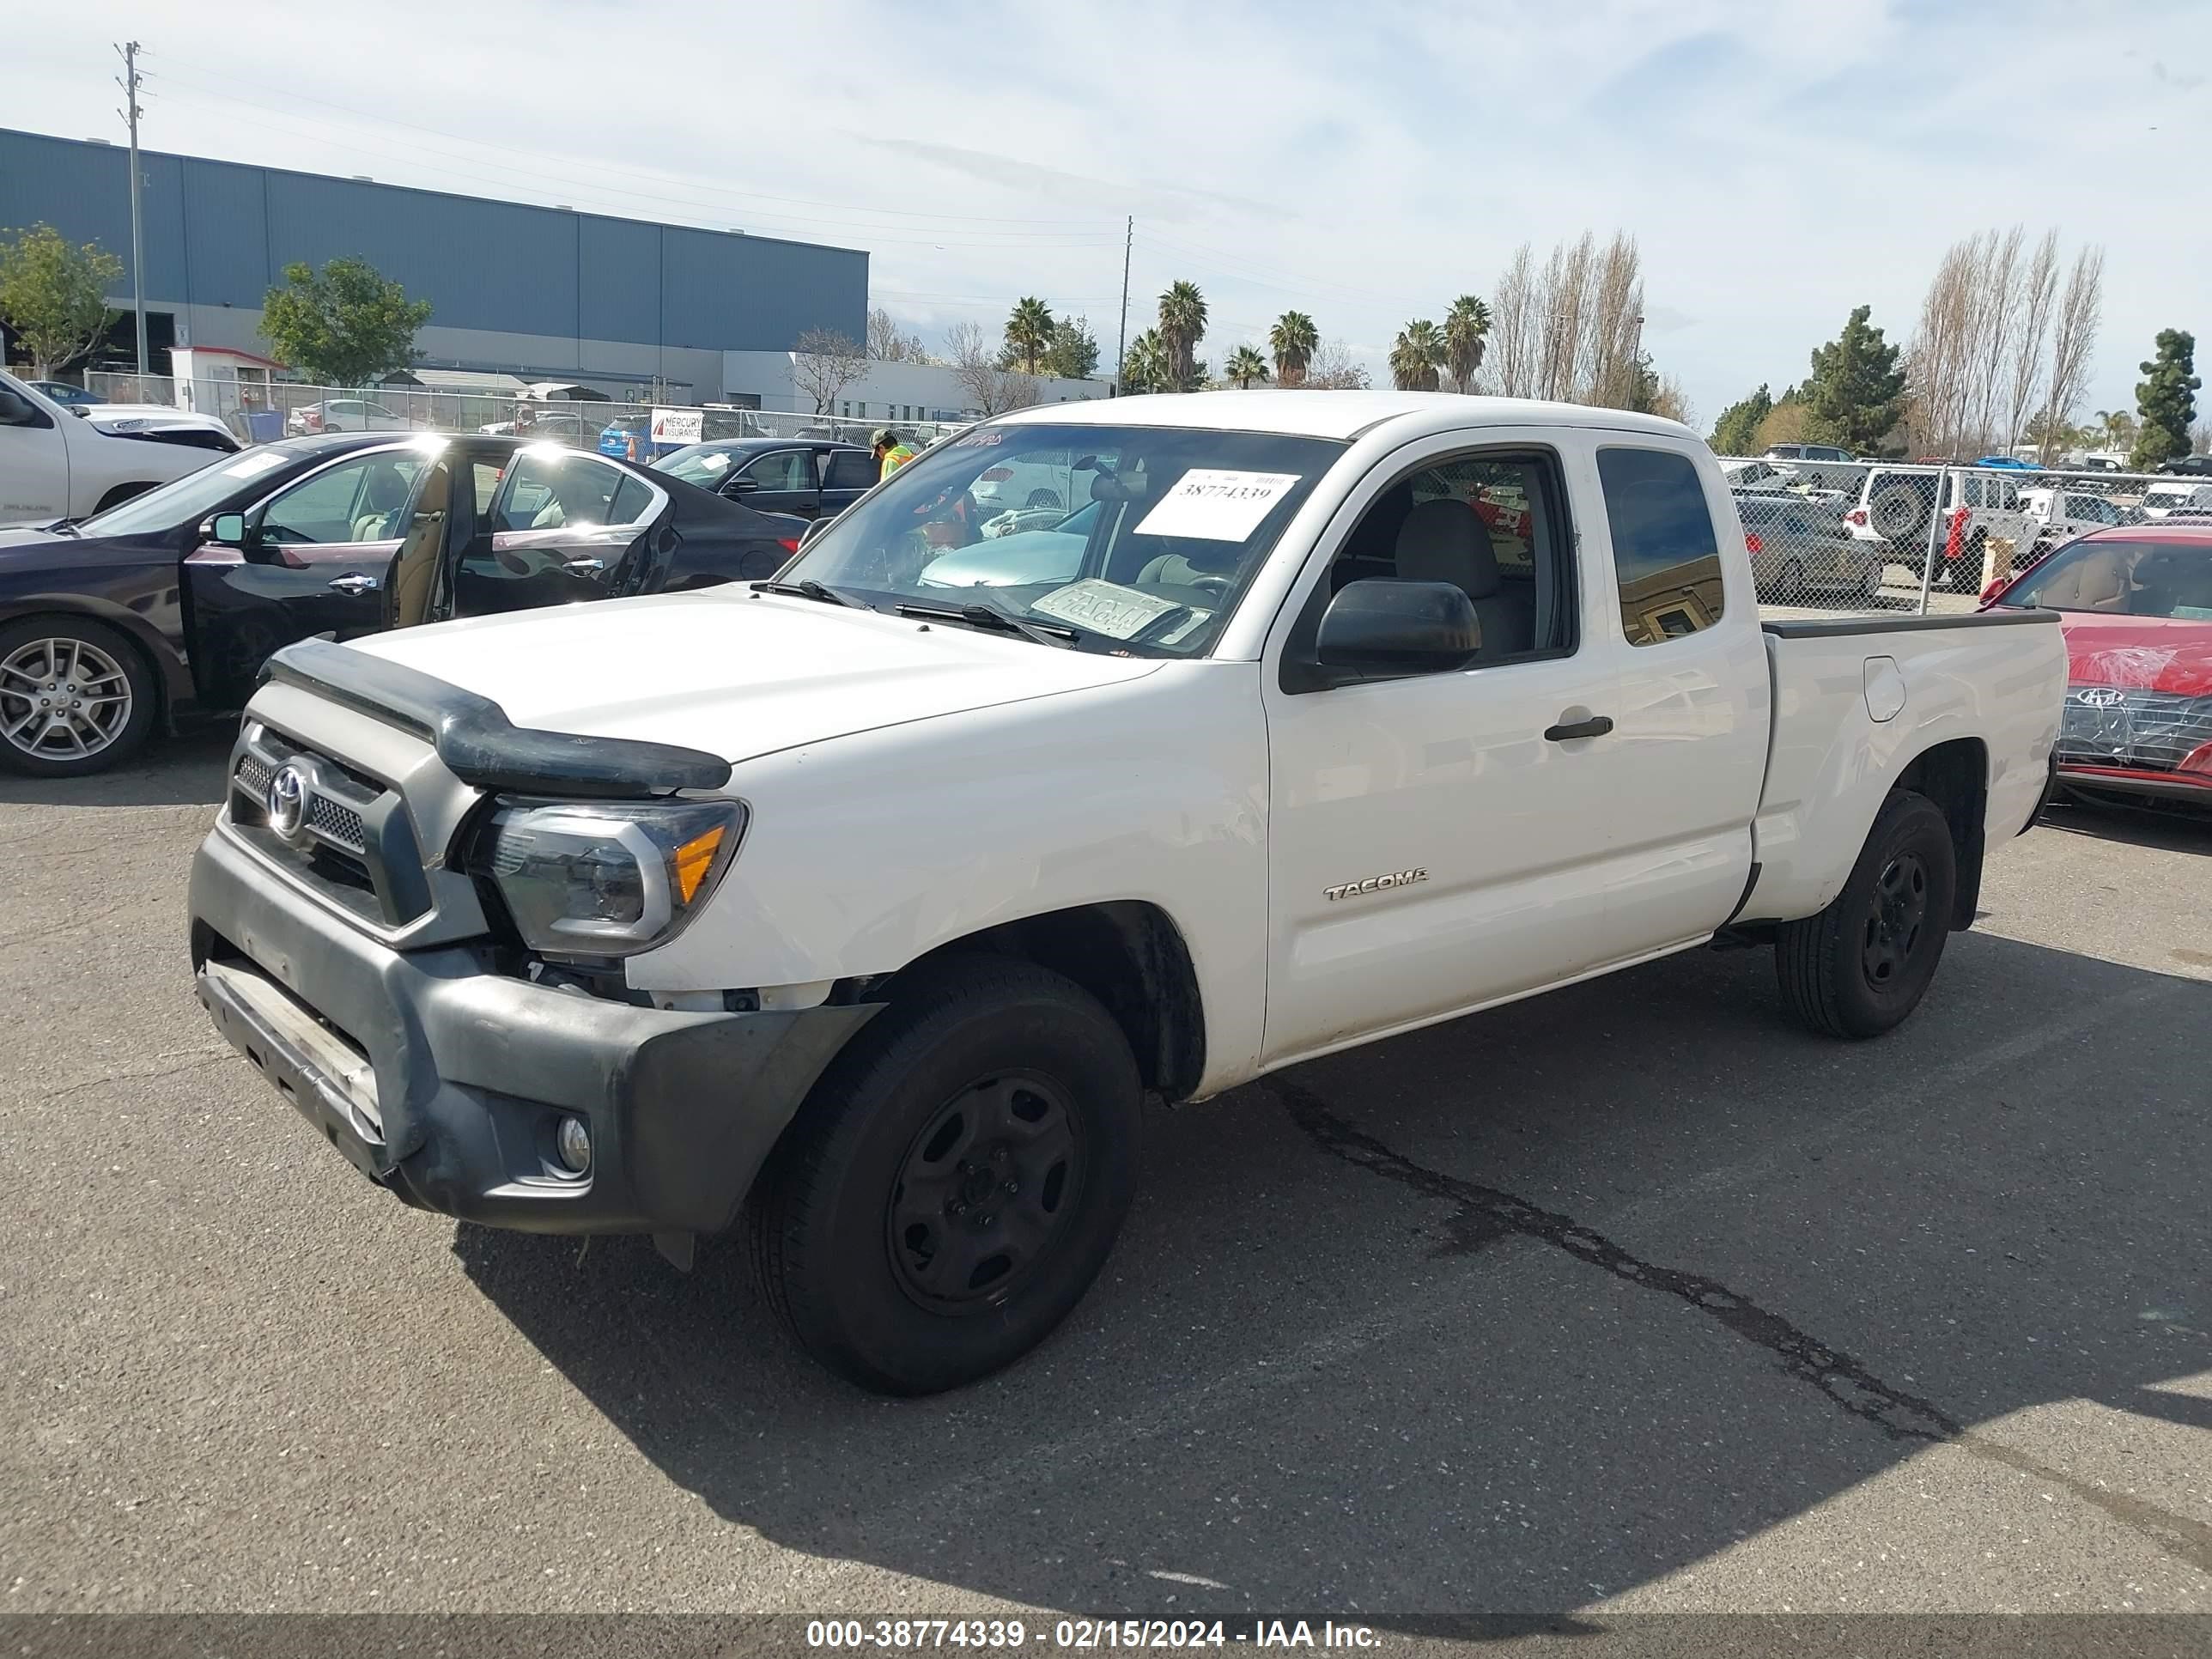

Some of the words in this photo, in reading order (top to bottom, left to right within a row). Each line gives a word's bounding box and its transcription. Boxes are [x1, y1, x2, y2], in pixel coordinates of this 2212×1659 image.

[665, 417, 702, 428] MERCURY
[665, 428, 702, 438] INSURANCE
[1179, 484, 1272, 500] 38774339
[1322, 866, 1430, 901] TACOMA
